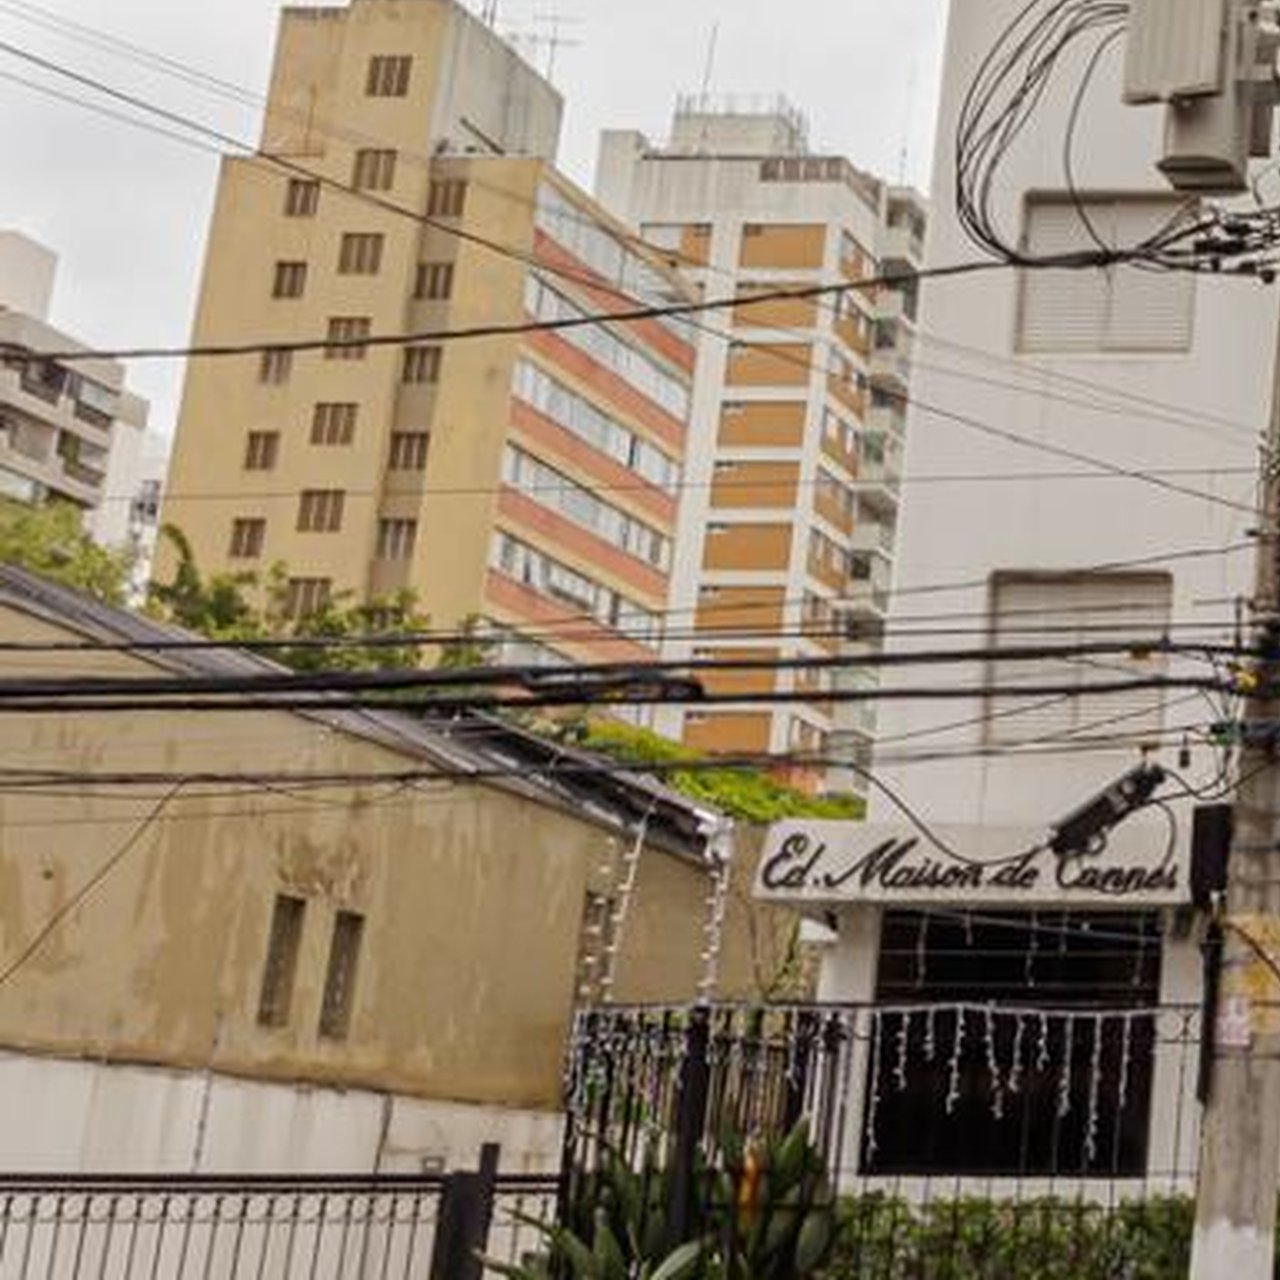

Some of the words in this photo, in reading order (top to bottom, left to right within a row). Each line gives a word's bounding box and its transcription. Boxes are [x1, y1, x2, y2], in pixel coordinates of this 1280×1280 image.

[763, 832, 825, 889] Ed.
[825, 836, 983, 889] Maison
[987, 847, 1038, 888] de
[1056, 850, 1178, 894] Cannes
